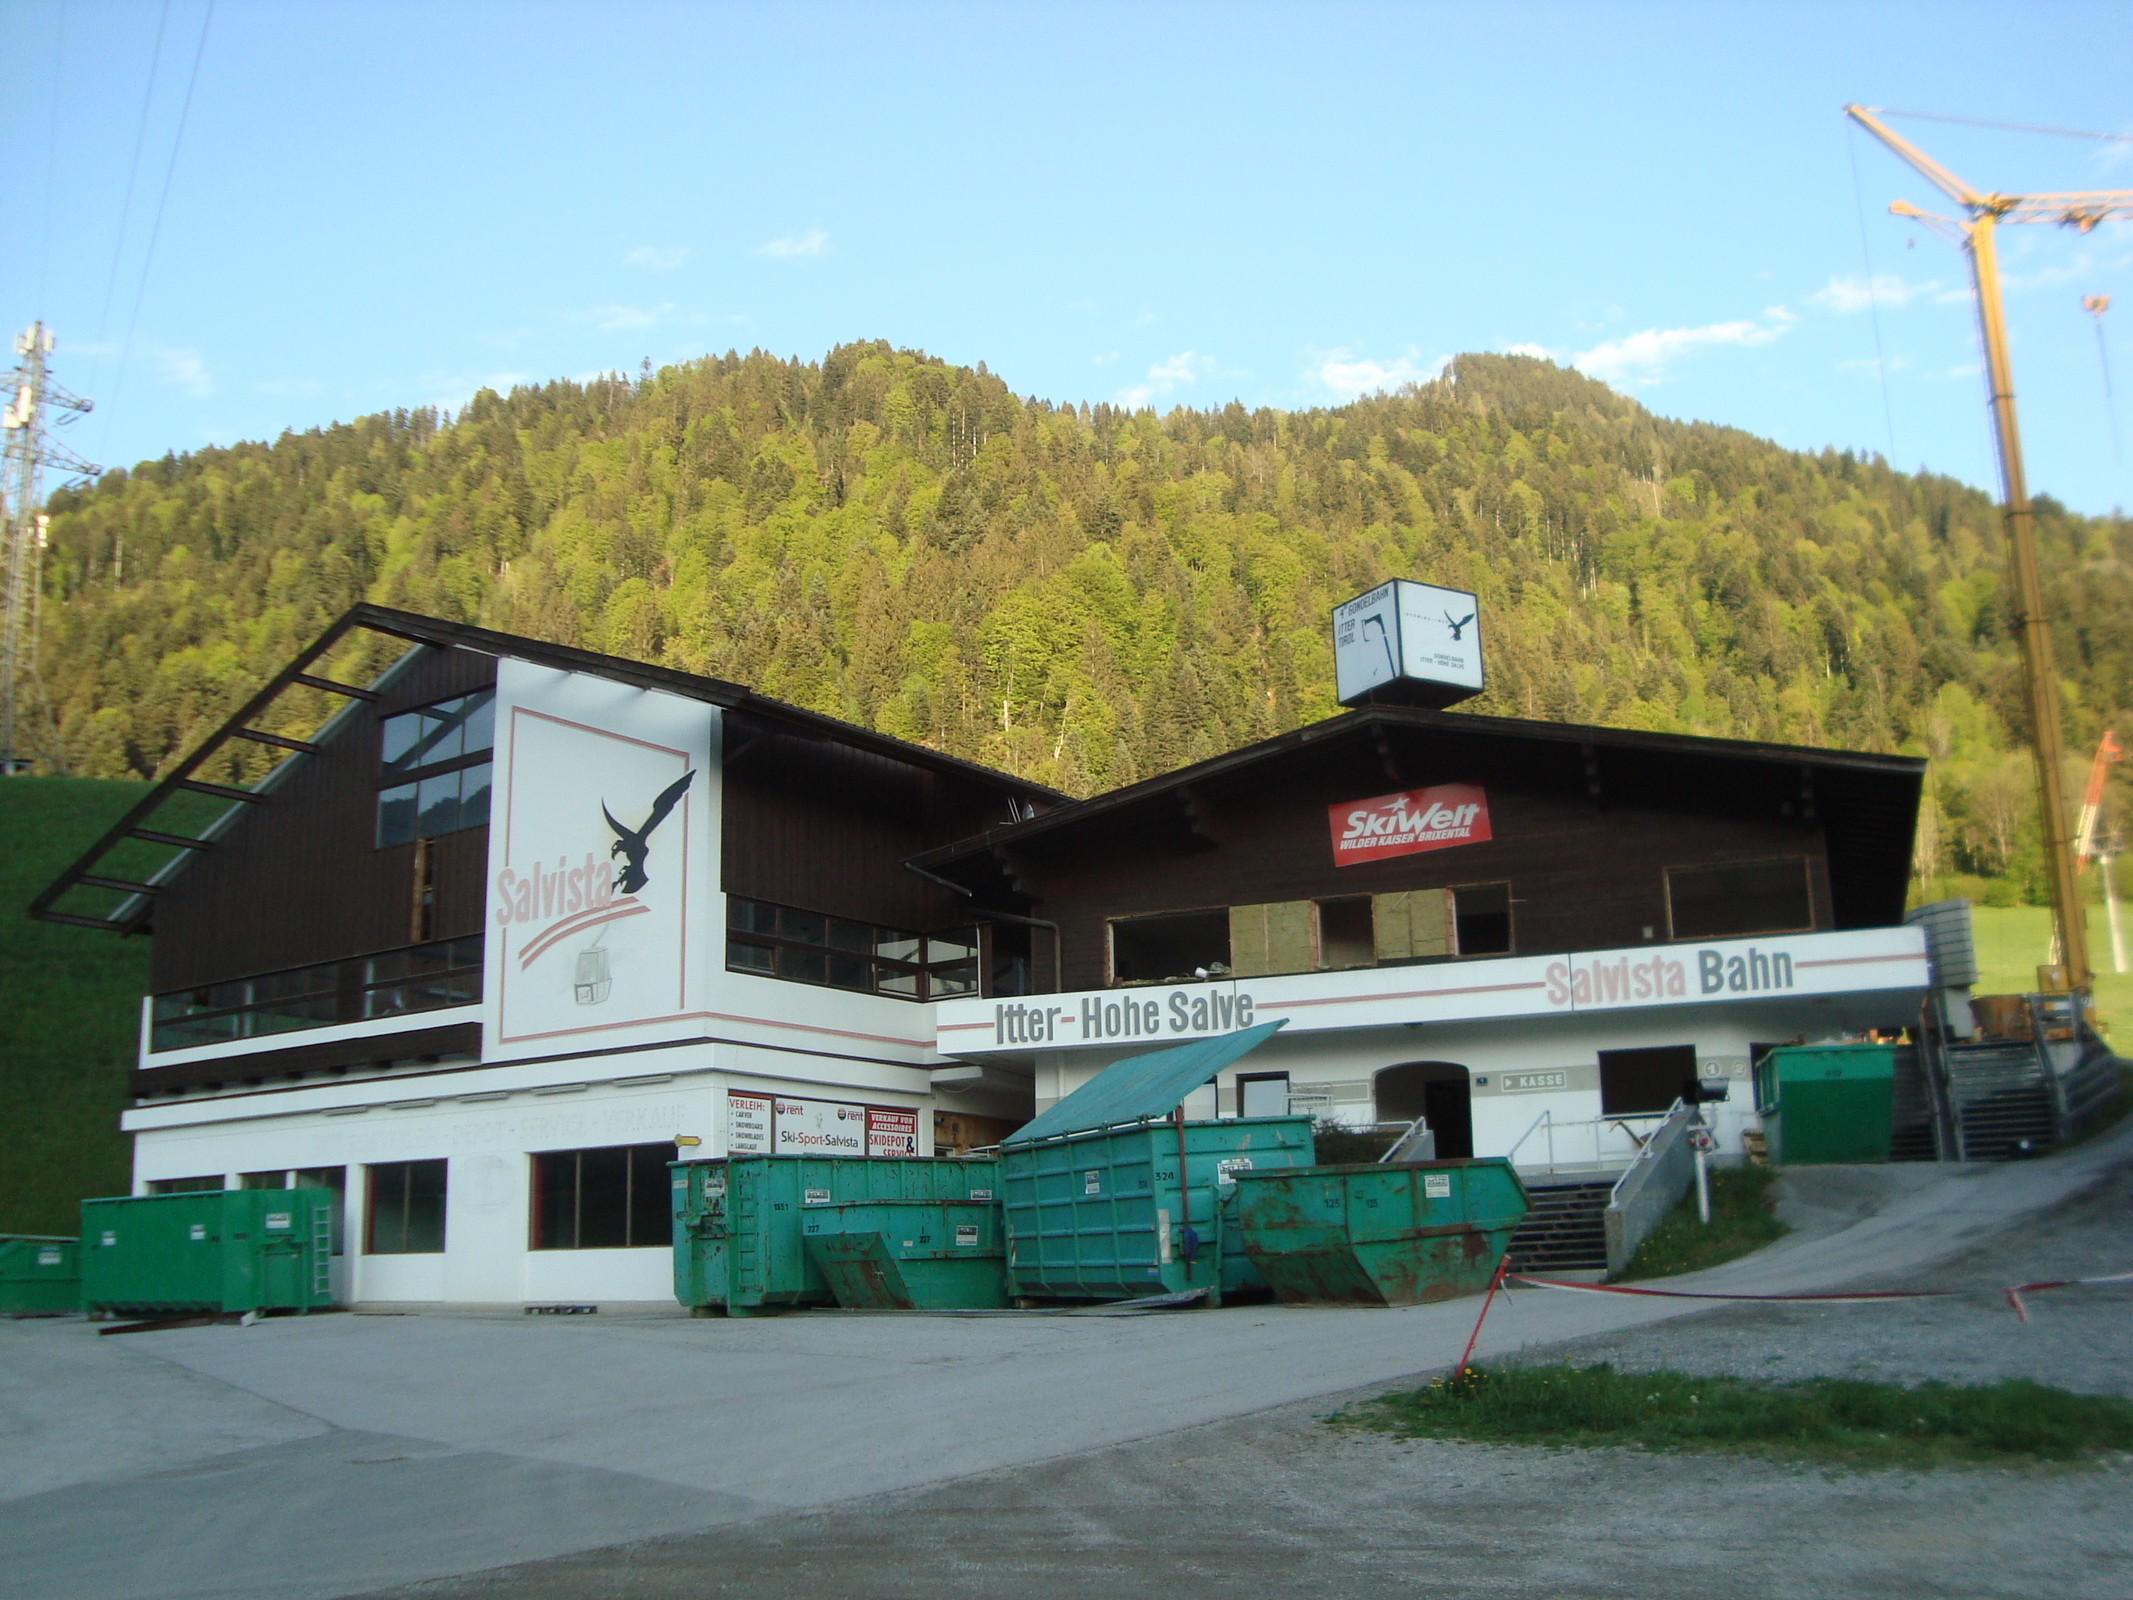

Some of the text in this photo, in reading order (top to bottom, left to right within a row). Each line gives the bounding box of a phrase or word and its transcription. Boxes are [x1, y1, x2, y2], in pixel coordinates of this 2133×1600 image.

[1348, 586, 1389, 616] GONDELBAHN
[1338, 618, 1356, 636] ITTER
[1338, 632, 1356, 648] TIROL
[1342, 800, 1480, 839] SkiWelt
[1339, 827, 1471, 850] WILDER KAISER BRIXENTAL
[497, 852, 613, 927] Salvista
[1545, 947, 1794, 1005] Salvista Bahn
[1081, 995, 1160, 1039] Hohe
[1169, 989, 1254, 1032] Salve
[1519, 1073, 1563, 1088] KASSE
[729, 1099, 765, 1112] VERLEIH:
[786, 1106, 804, 1116] rent
[847, 1111, 864, 1122] rent
[735, 1121, 763, 1131] SNOWBOARD
[781, 1131, 859, 1148] Ski-Sport-Salvista
[869, 1134, 905, 1147] SKIDEPOT
